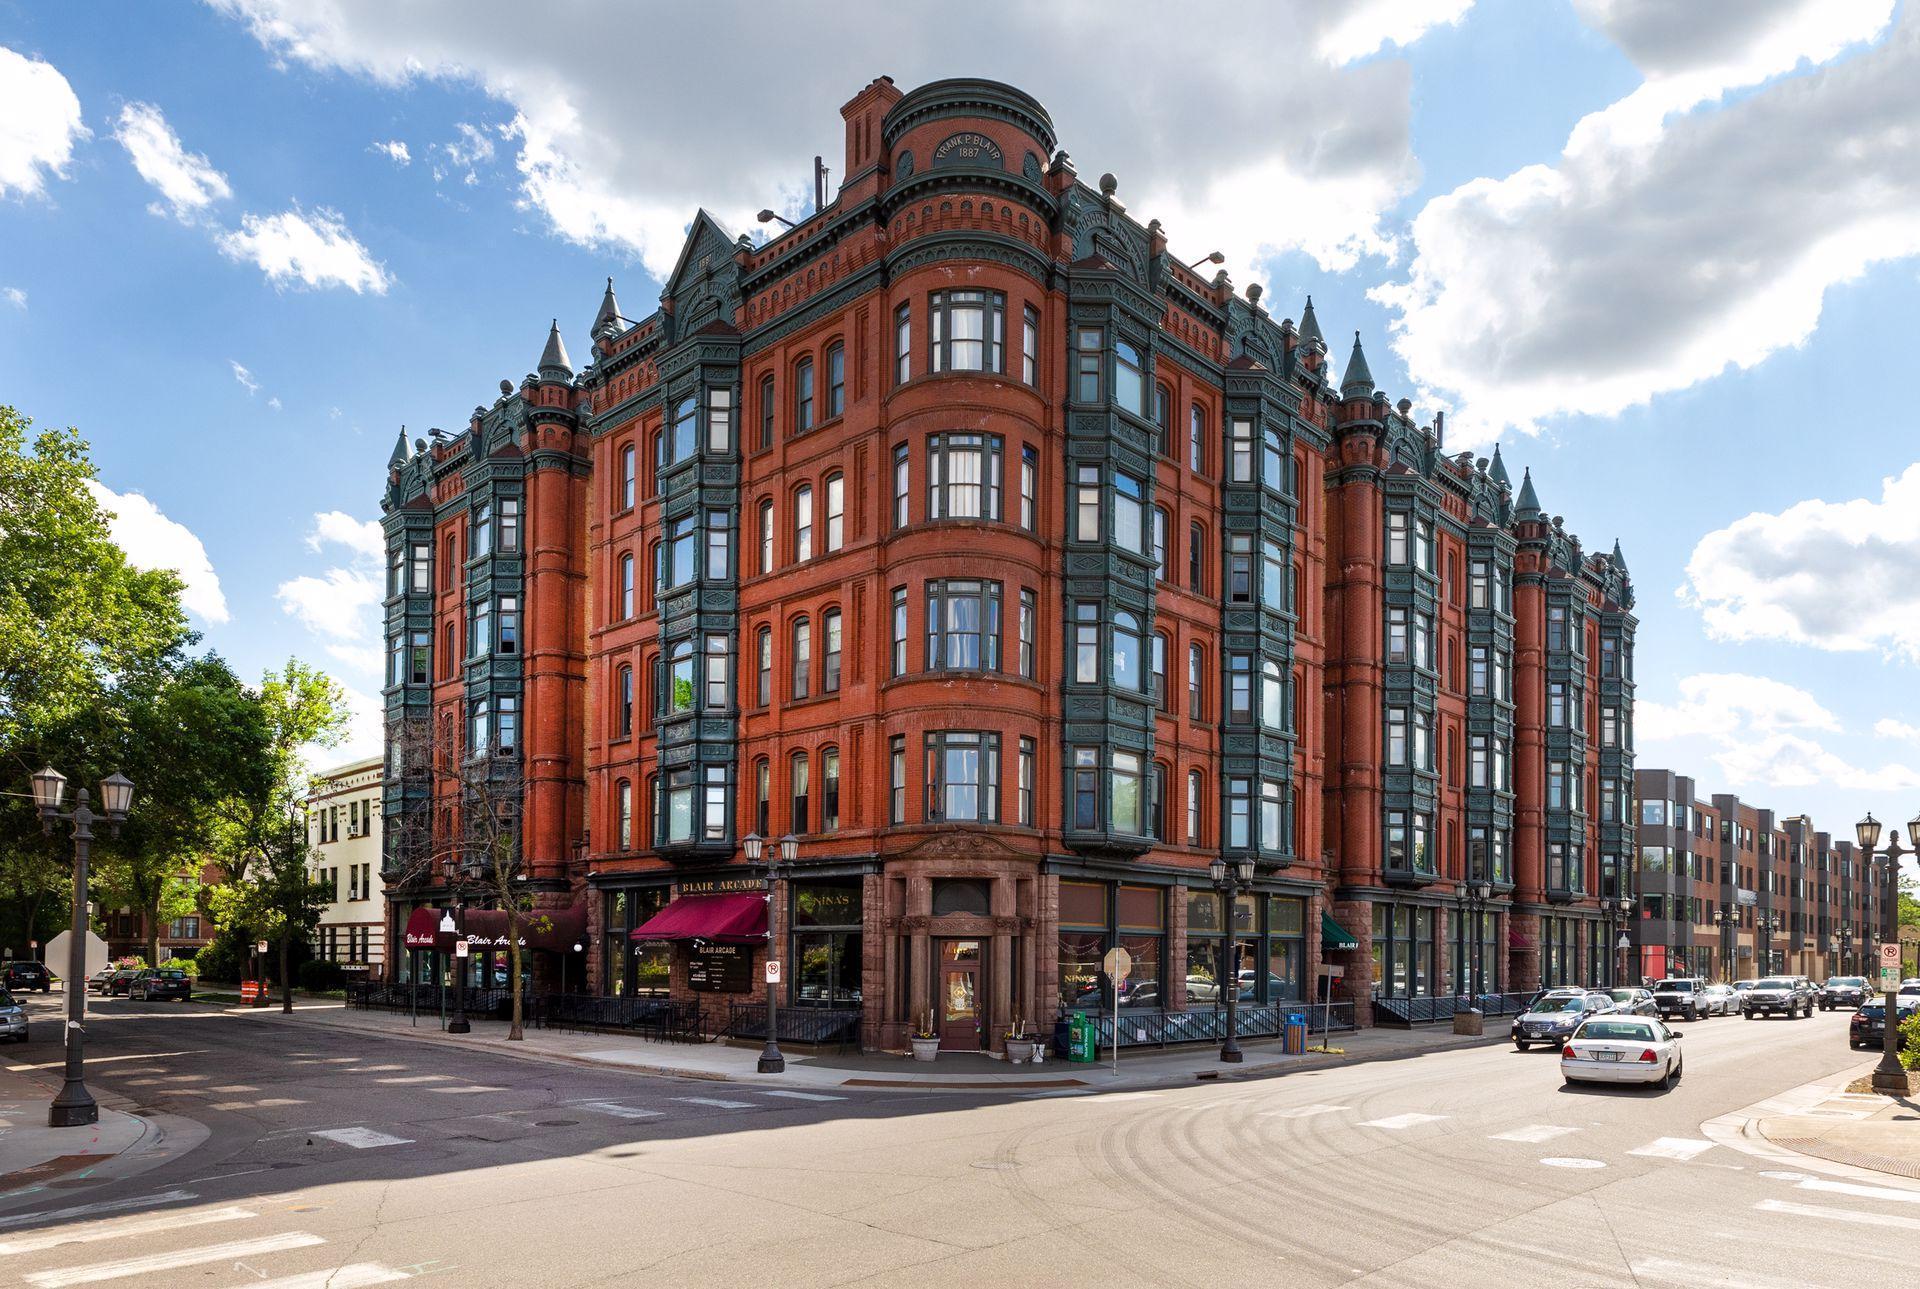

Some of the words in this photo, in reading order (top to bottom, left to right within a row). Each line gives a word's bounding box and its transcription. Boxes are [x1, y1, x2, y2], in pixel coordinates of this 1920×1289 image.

[936, 136, 963, 158] FRANK
[973, 135, 1001, 159] BLAIR
[959, 147, 979, 158] 1887
[683, 881, 714, 891] BLAIR
[719, 879, 762, 890] ARCADE
[466, 934, 492, 945] Blair
[699, 946, 715, 954] BLAIR
[715, 946, 736, 954] ARCADE
